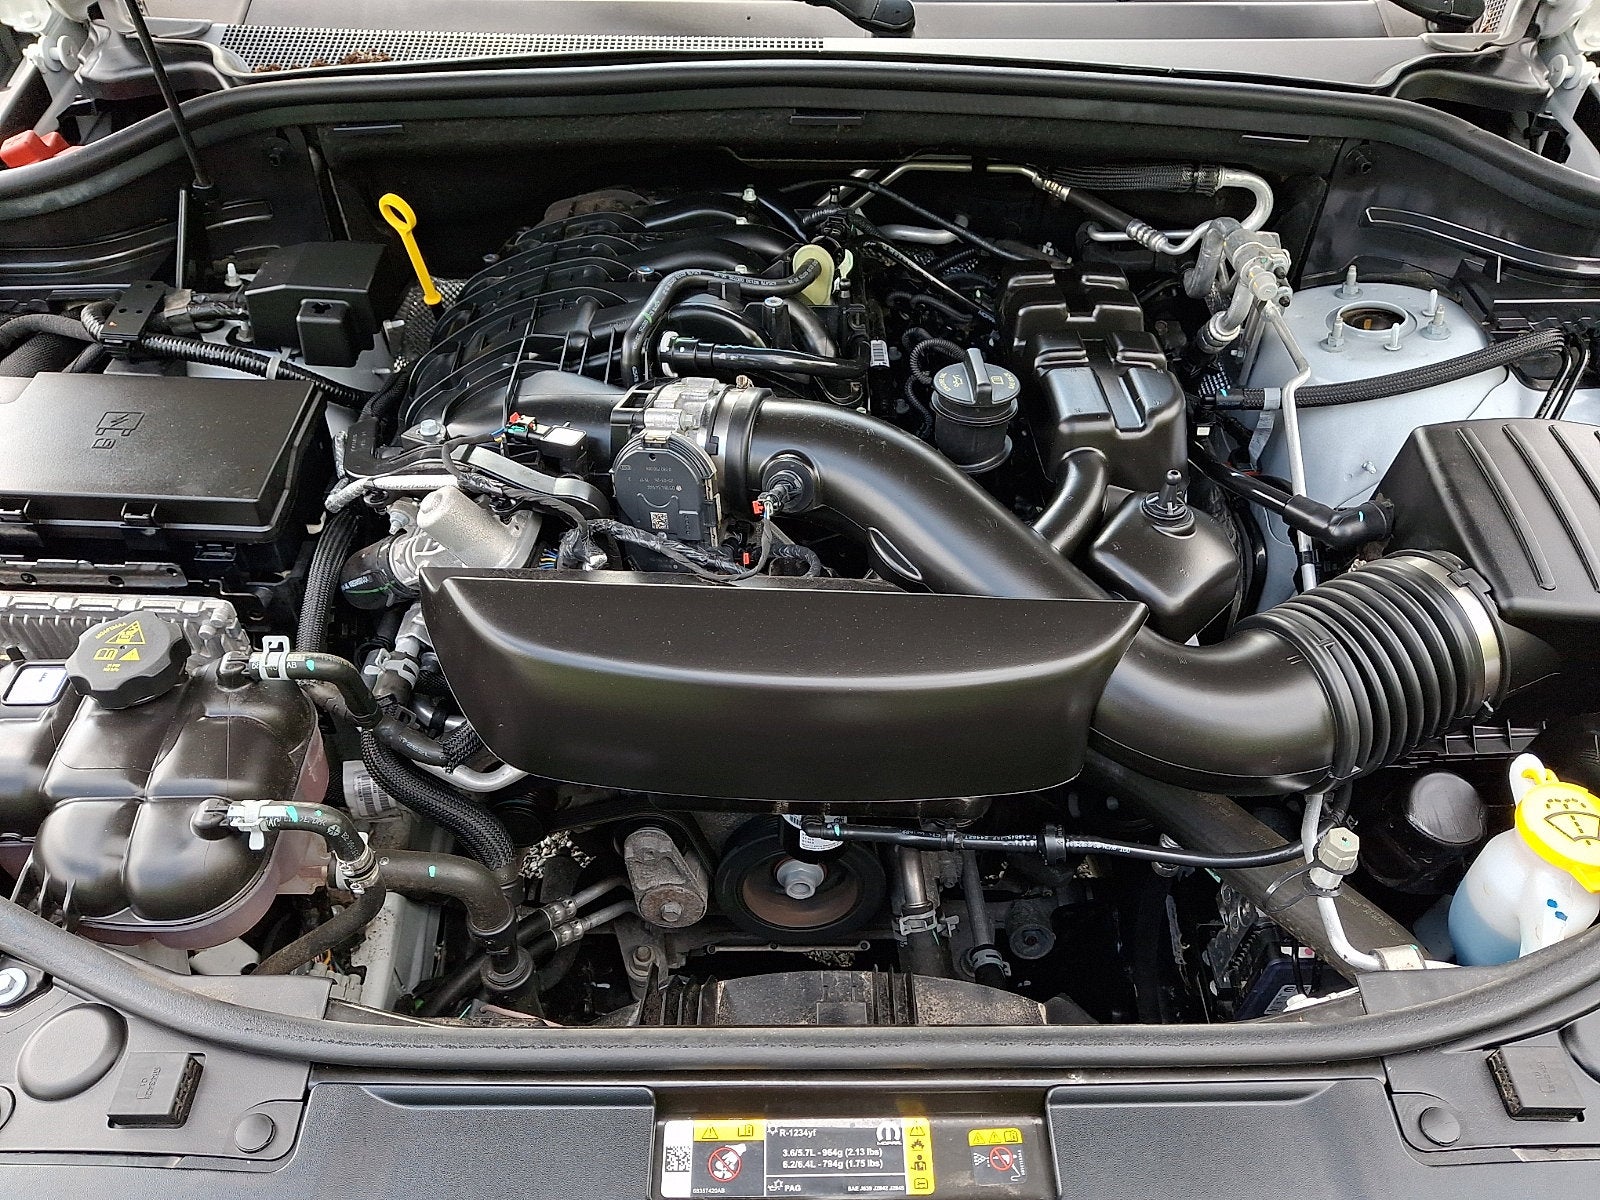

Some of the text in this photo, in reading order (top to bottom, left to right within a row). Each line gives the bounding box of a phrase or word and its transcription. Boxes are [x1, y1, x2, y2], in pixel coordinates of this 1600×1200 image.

[779, 1129, 817, 1137] R-1234yf
[782, 1149, 815, 1157] 3.6/5.7L
[845, 1148, 865, 1158] (2.13
[867, 1148, 883, 1158] lbs)
[782, 1160, 816, 1169] 6.2/6.4L
[822, 1160, 844, 1169] 794g
[845, 1159, 866, 1169] (1.75
[867, 1159, 884, 1169] lbs)
